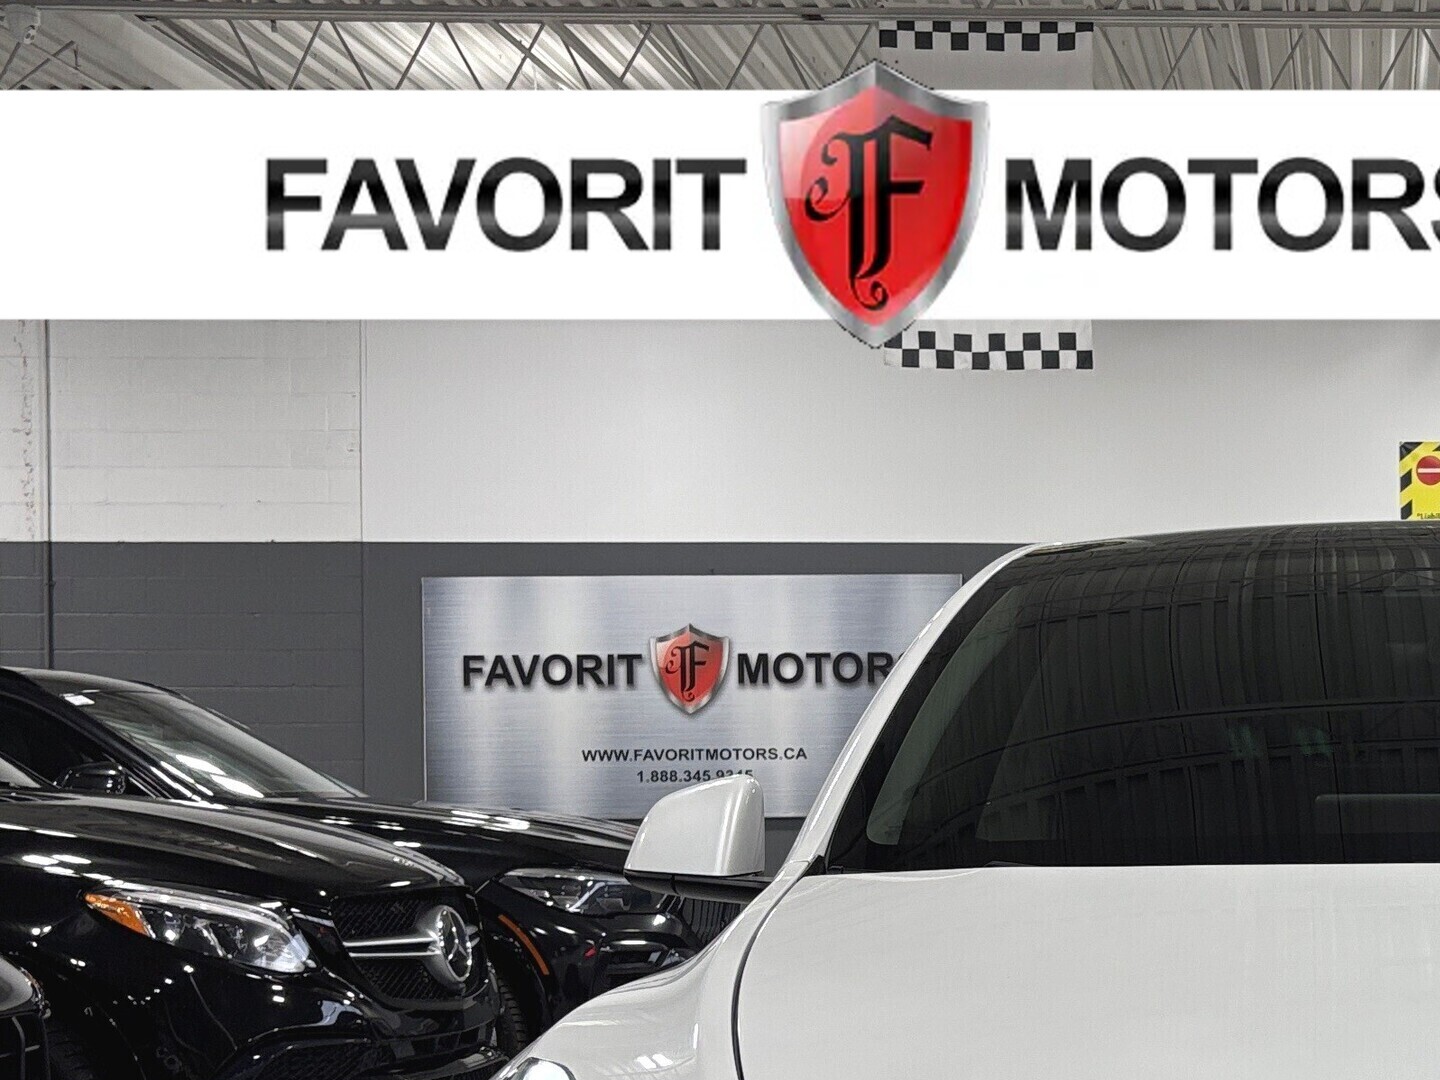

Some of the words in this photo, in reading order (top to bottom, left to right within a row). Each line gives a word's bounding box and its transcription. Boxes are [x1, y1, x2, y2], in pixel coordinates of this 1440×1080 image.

[462, 653, 643, 687] FAVORIT
[738, 651, 905, 685] MOTOR
[581, 748, 808, 762] WWW.FAVORITMOTORS.CA
